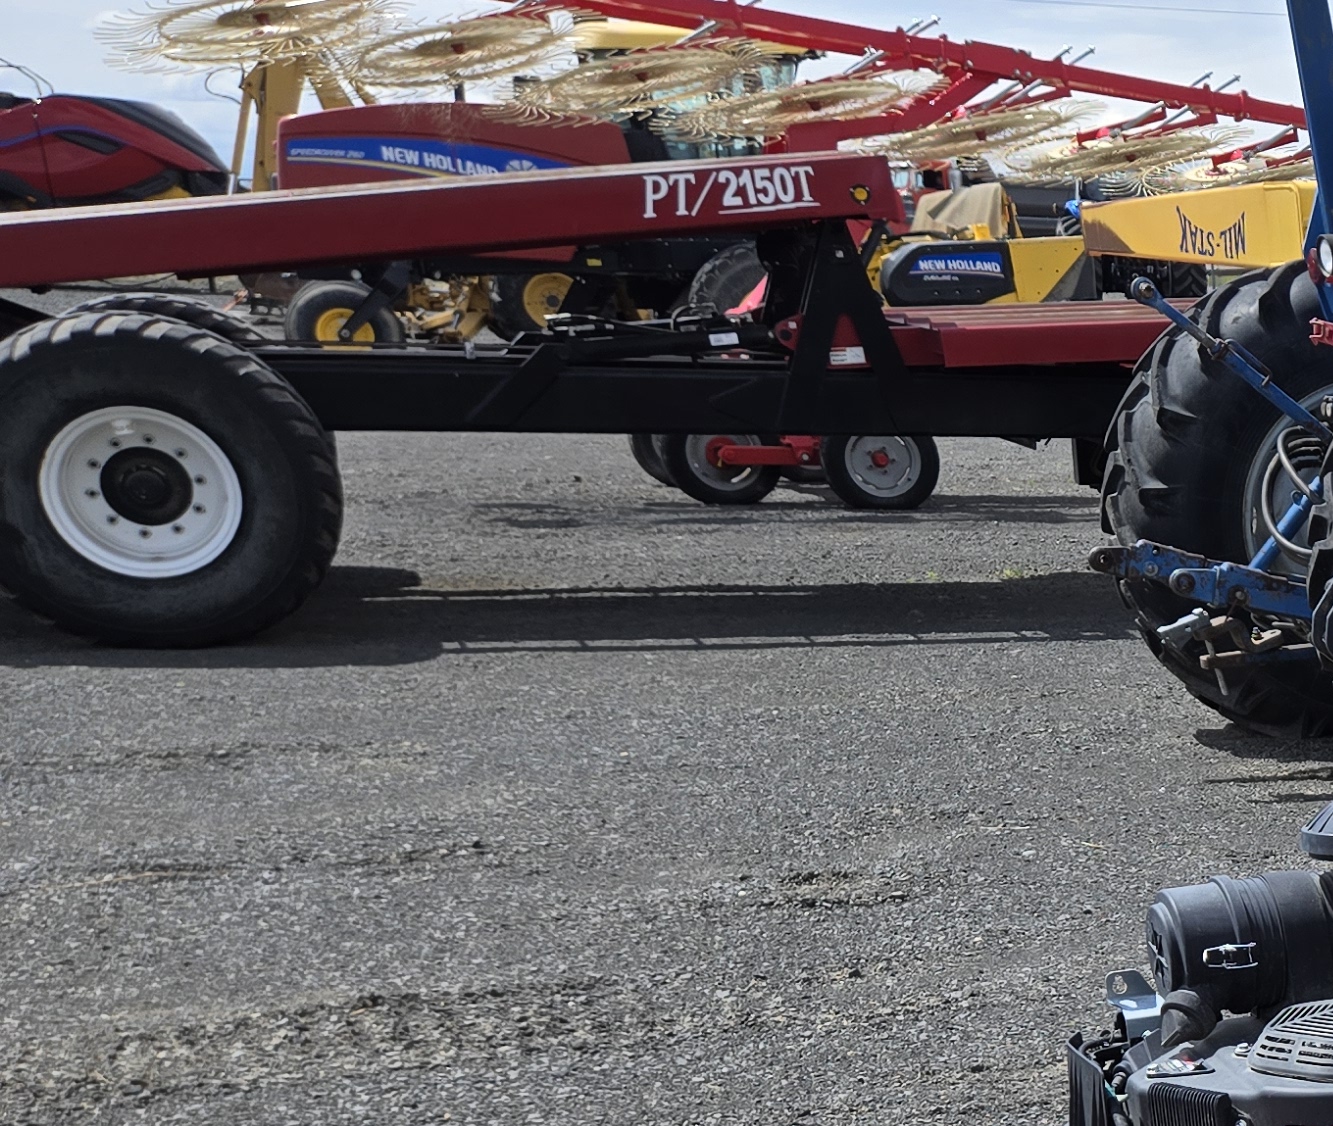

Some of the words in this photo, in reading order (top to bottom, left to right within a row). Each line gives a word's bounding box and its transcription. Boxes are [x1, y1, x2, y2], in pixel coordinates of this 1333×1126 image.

[380, 146, 420, 166] NEW
[643, 166, 815, 219] PT/2150T
[918, 259, 946, 271] NEW
[947, 259, 1001, 273] HOLLAND
